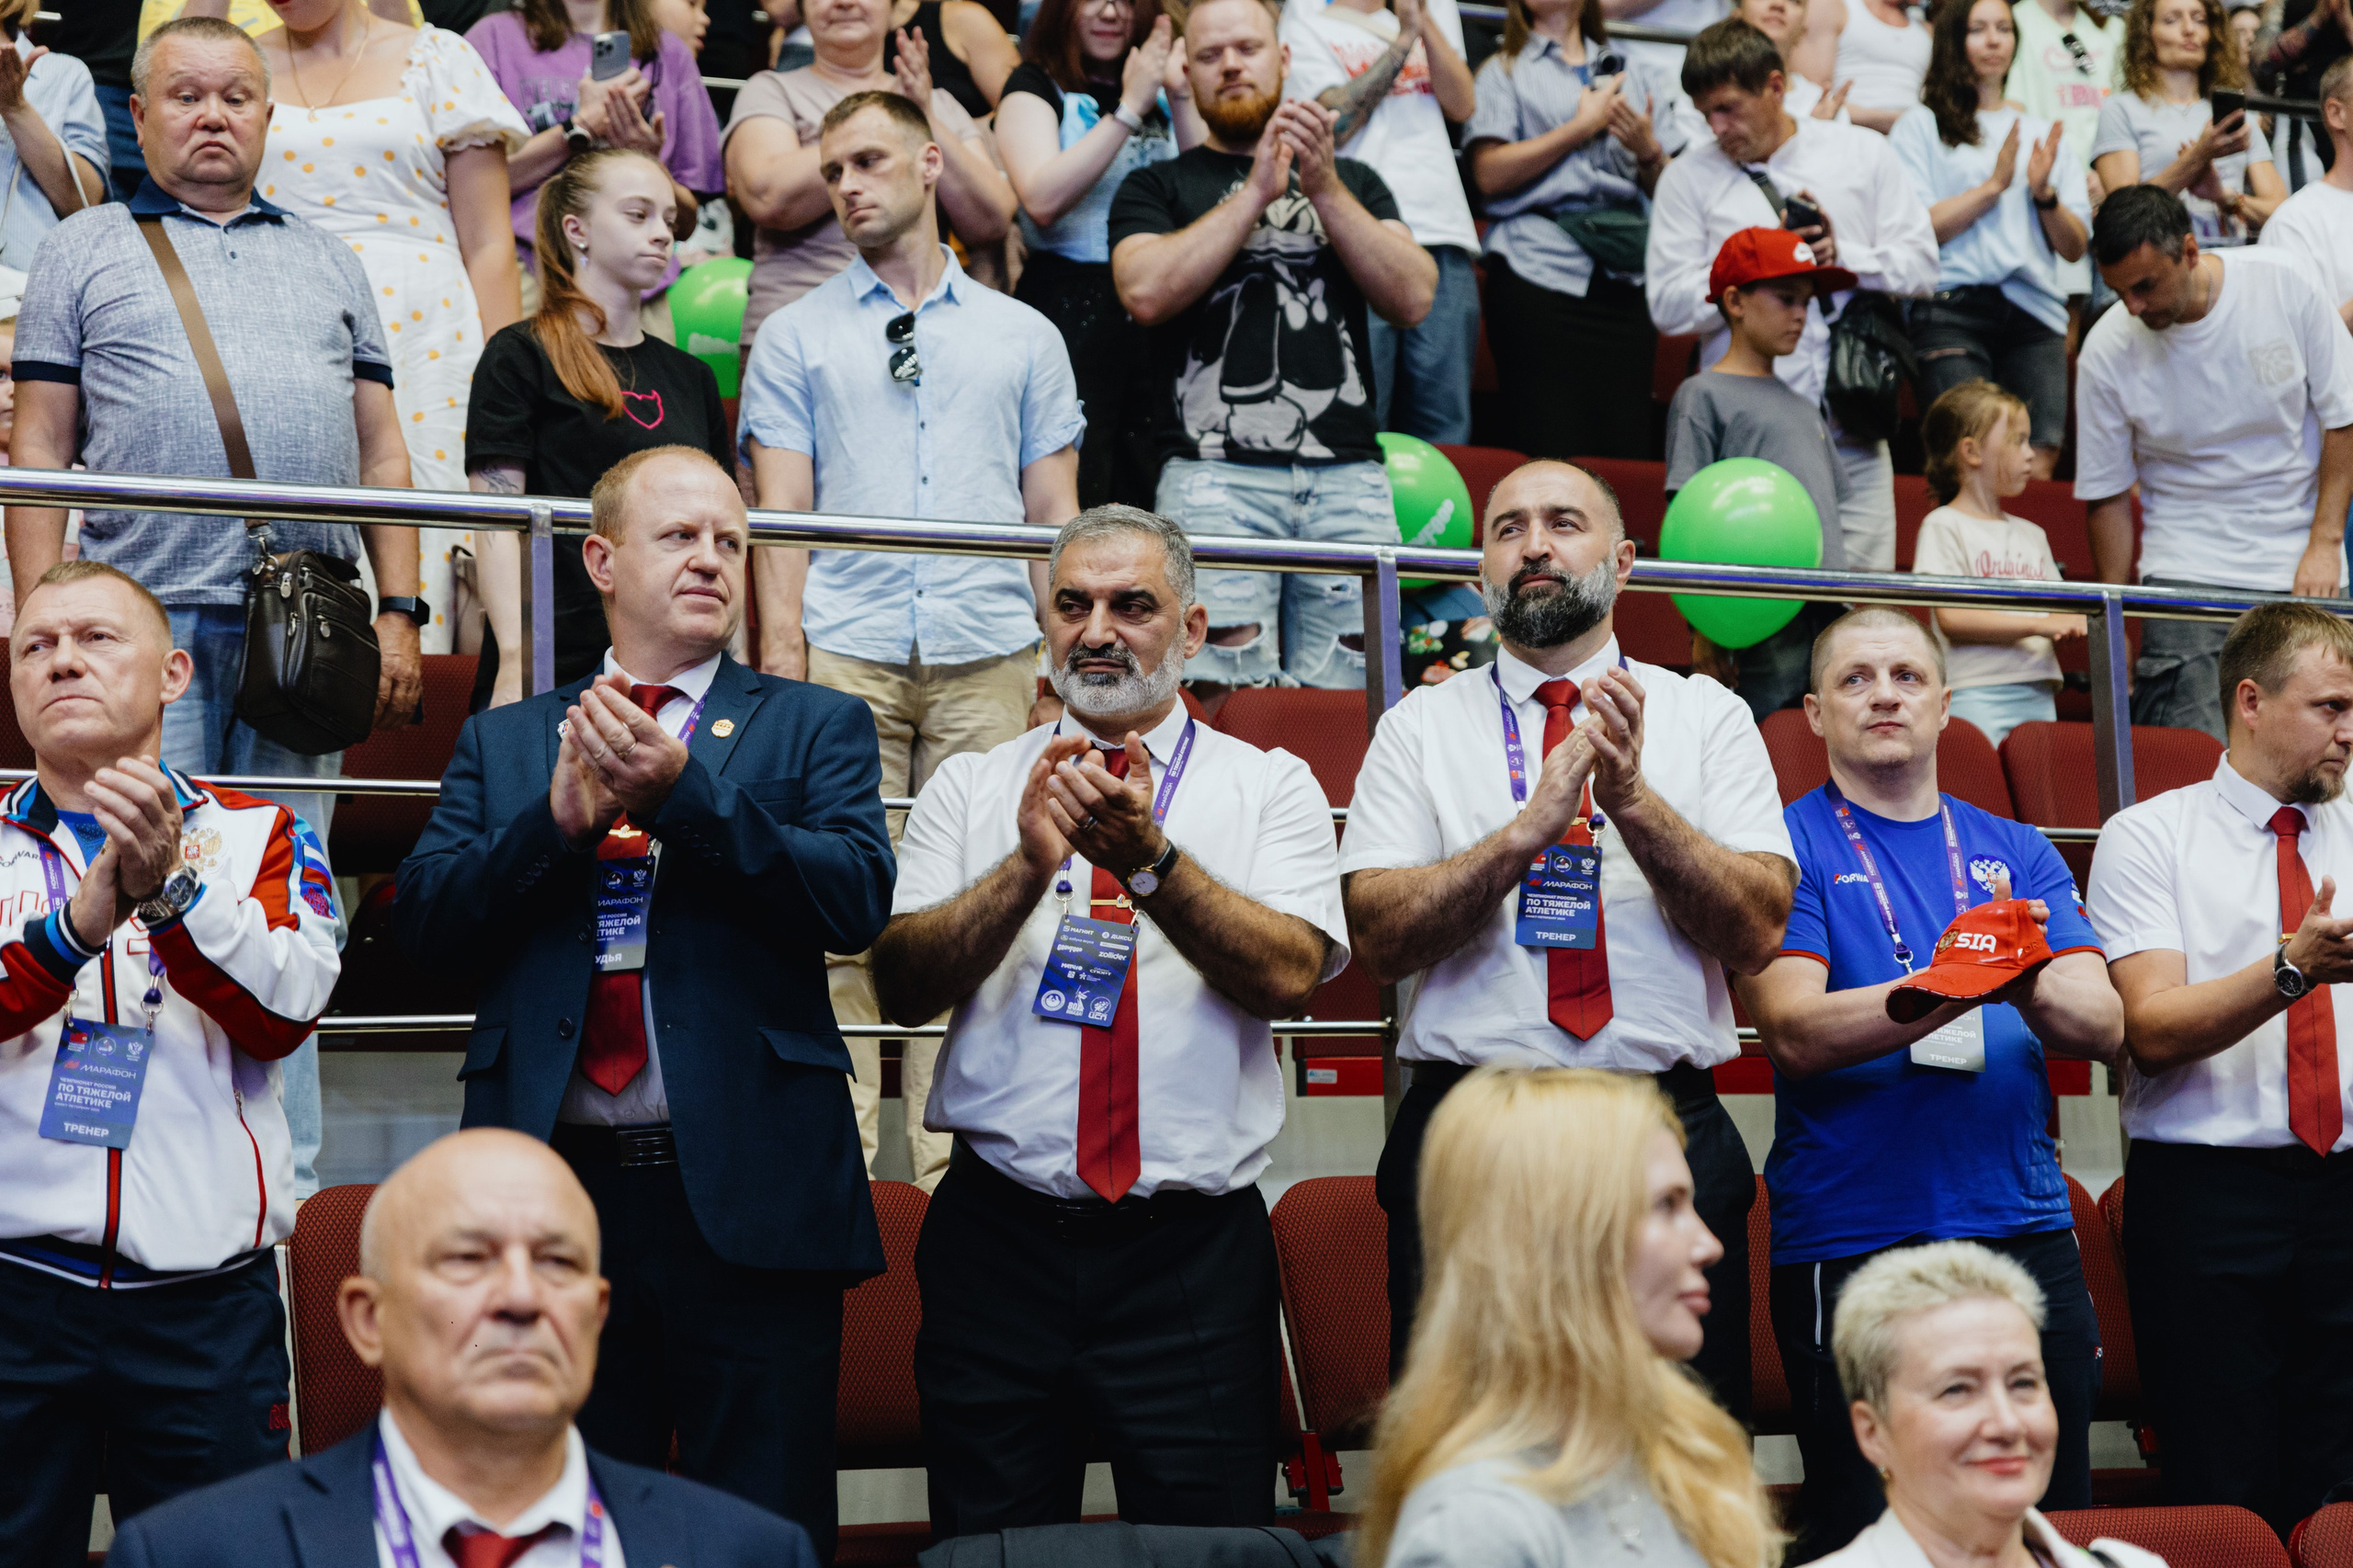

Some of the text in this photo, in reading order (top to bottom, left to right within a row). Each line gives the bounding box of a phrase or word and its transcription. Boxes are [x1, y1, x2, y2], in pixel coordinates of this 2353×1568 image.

[1835, 874, 1869, 883] FORWA
[1543, 881, 1593, 891] МАРАФОН
[1526, 898, 1591, 910] ПО ТЯЖЕЛОЙ
[1525, 906, 1575, 917] АТЛЕТИКЕ
[597, 915, 642, 928] ЯЖЕЛОЙ
[1070, 927, 1095, 936] МАГНИТ
[1536, 931, 1576, 942] ТРЕНЕР
[595, 953, 623, 965] УДЬЯ
[1928, 1033, 1963, 1044] ЛЕТИКЕ
[1936, 1028, 1977, 1040] ЯЖЕЛОЙ
[1929, 1053, 1967, 1064] ТРЕНЕР
[80, 1064, 136, 1079] МАРАФОН
[58, 1083, 131, 1102] ПО ТЯЖЕЛОЙ
[55, 1093, 112, 1108] АТЛЕТИКЕ
[63, 1122, 109, 1138] ТРЕНЕР
